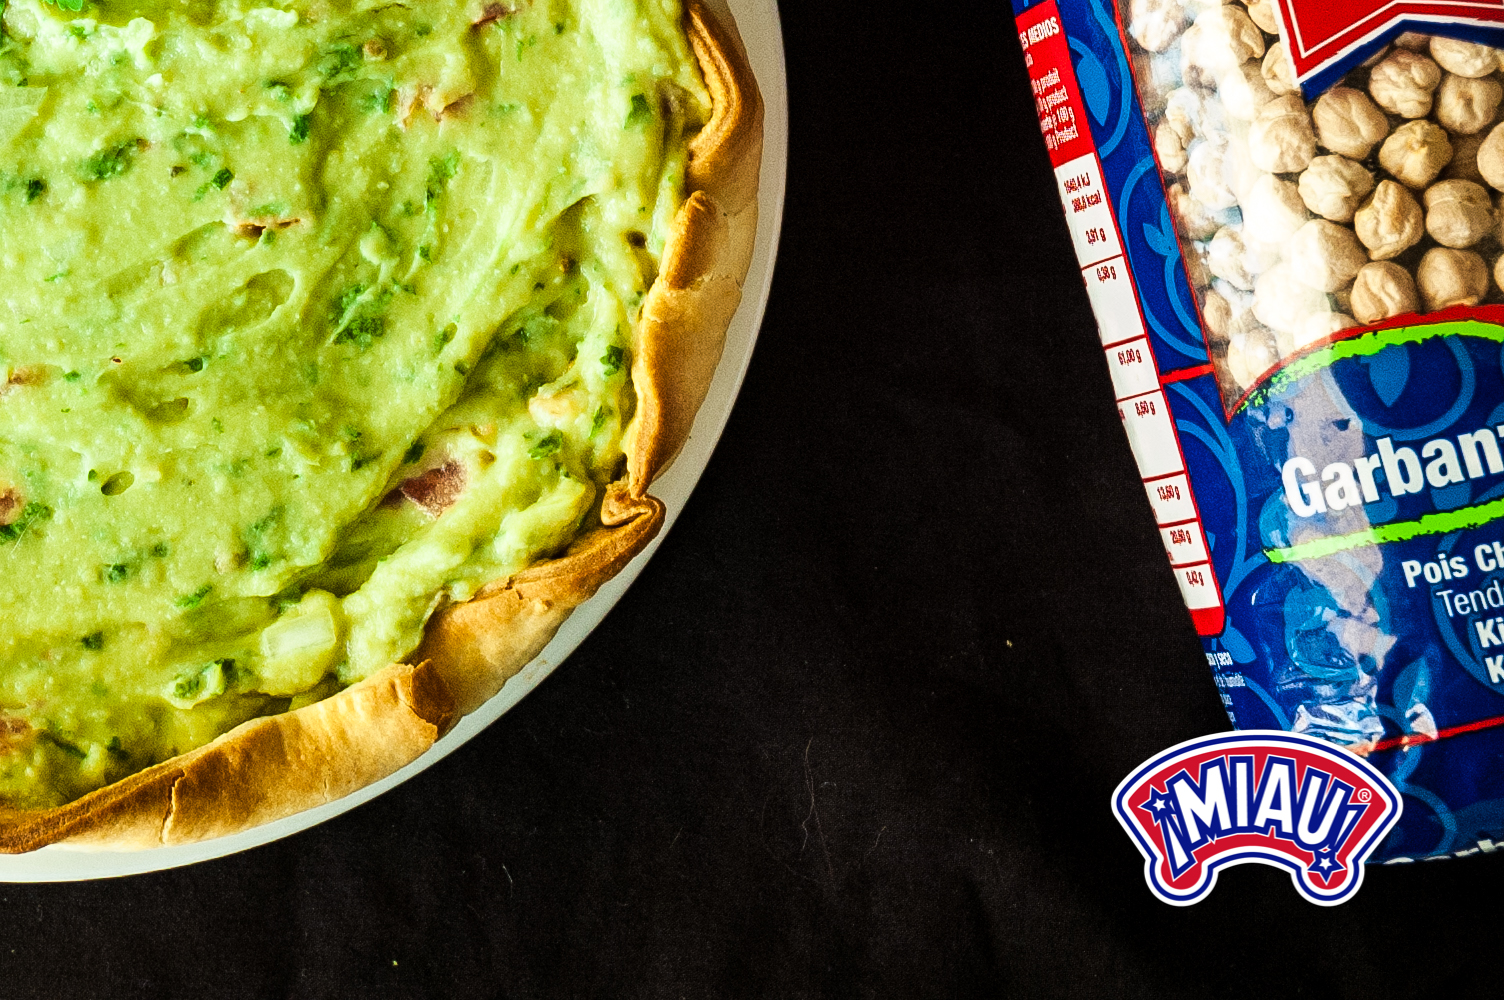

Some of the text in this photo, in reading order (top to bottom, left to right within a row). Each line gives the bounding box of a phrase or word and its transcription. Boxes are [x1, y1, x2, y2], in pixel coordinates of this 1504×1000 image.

[1027, 17, 1059, 45] MEDIOS
[1282, 425, 1504, 518] Garban
[1402, 553, 1469, 588] Pois
